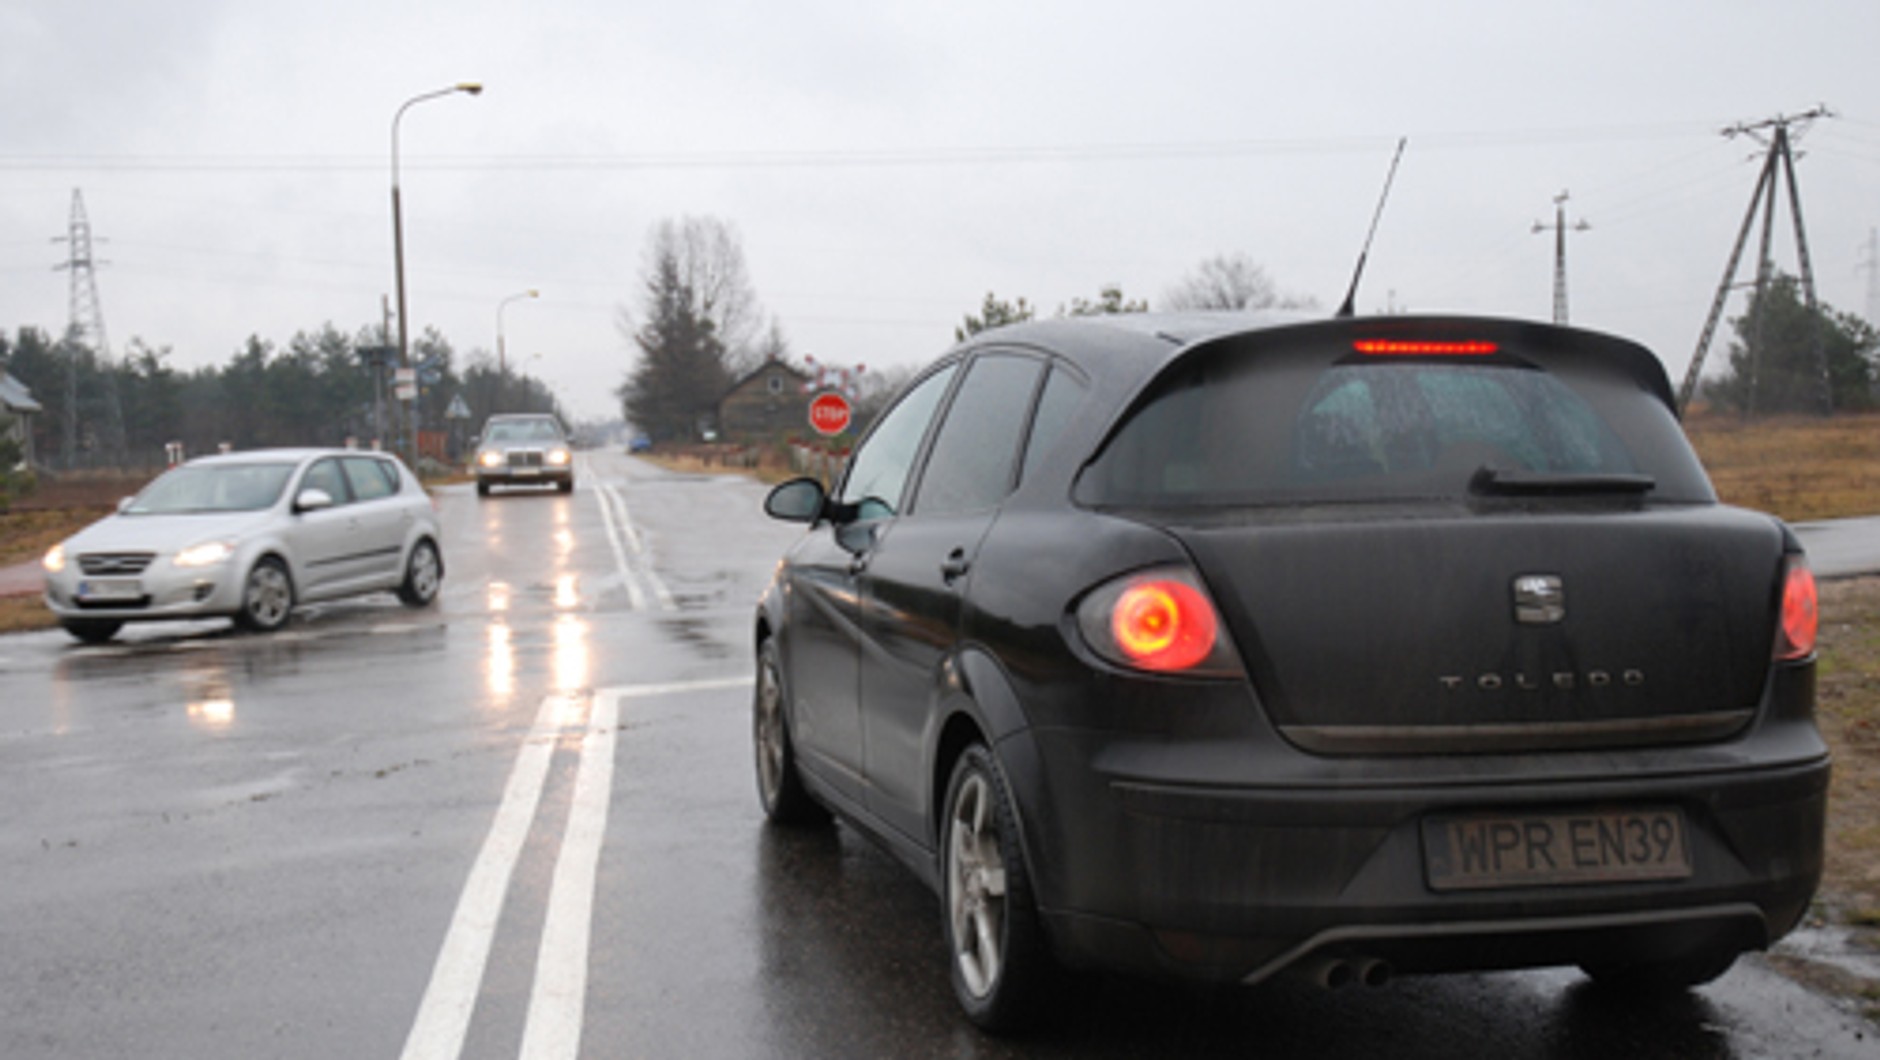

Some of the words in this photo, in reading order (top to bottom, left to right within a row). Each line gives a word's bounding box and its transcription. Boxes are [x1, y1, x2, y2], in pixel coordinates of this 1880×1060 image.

[814, 405, 848, 421] STOP
[1439, 669, 1645, 690] TOLEDO
[1456, 821, 1556, 873] WPR
[1568, 815, 1675, 868] EN39
